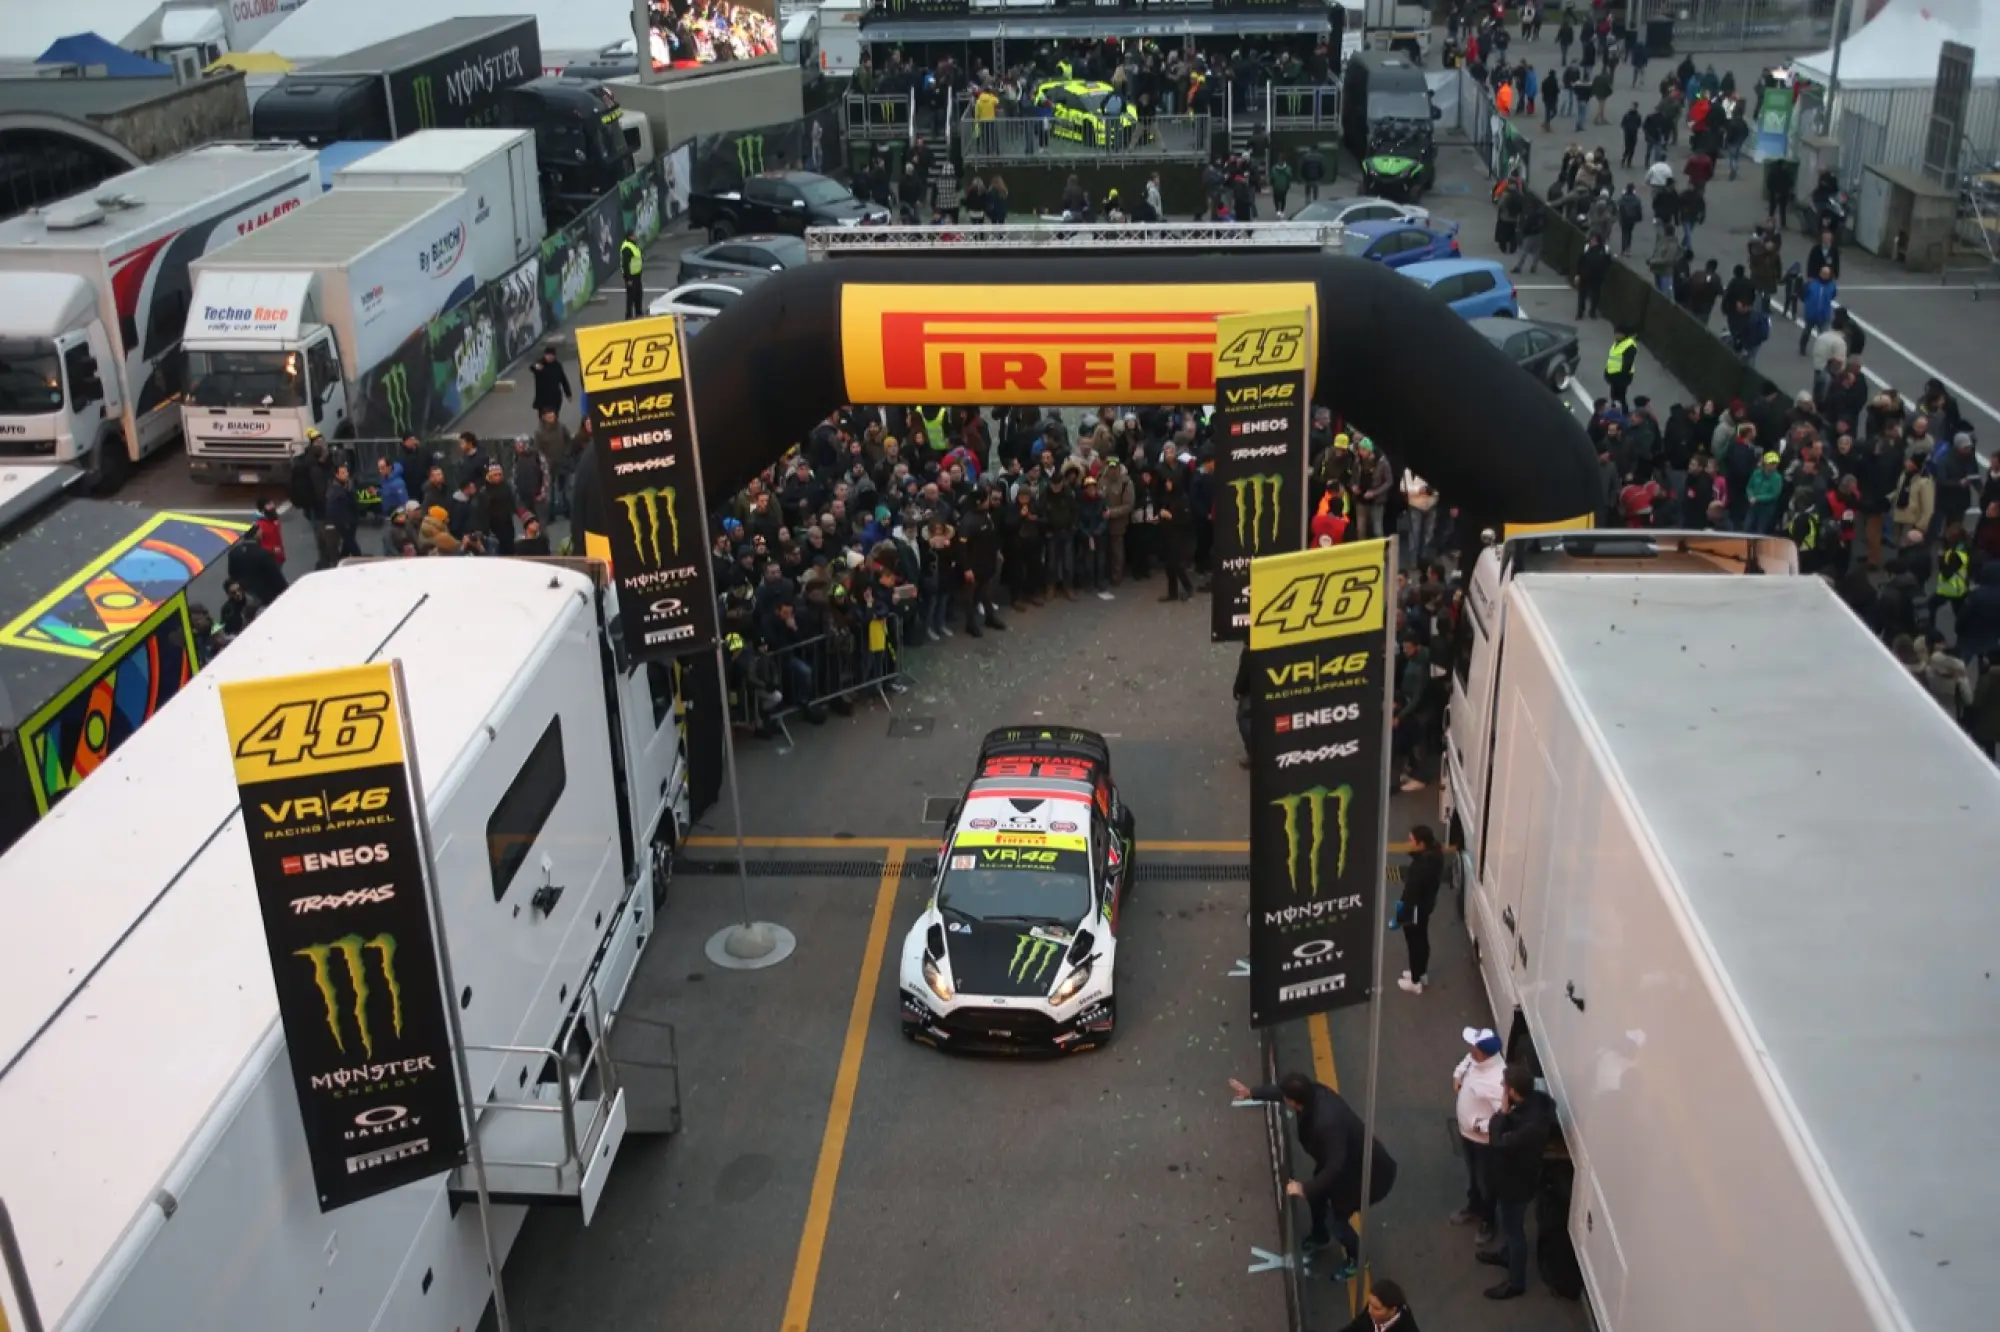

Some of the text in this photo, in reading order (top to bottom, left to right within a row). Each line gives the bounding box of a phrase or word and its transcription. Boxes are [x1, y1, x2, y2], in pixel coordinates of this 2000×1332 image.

[204, 305, 289, 321] Techno Race
[585, 333, 674, 381] 46
[880, 311, 1217, 390] PIRELL
[1219, 325, 1304, 368] 46
[622, 429, 673, 449] ENEOS
[1242, 418, 1289, 434] ENEOS
[1254, 564, 1381, 635] 46
[1265, 677, 1369, 700] RACING APPAREL
[235, 690, 391, 767] 46
[1291, 702, 1361, 730] ENEOS
[264, 814, 396, 840] RACING APPAREL
[303, 843, 391, 872] ENEOS
[289, 883, 396, 915] TRAXXAS
[310, 1055, 437, 1089] MONSTER
[344, 1116, 421, 1140] OAKLEY
